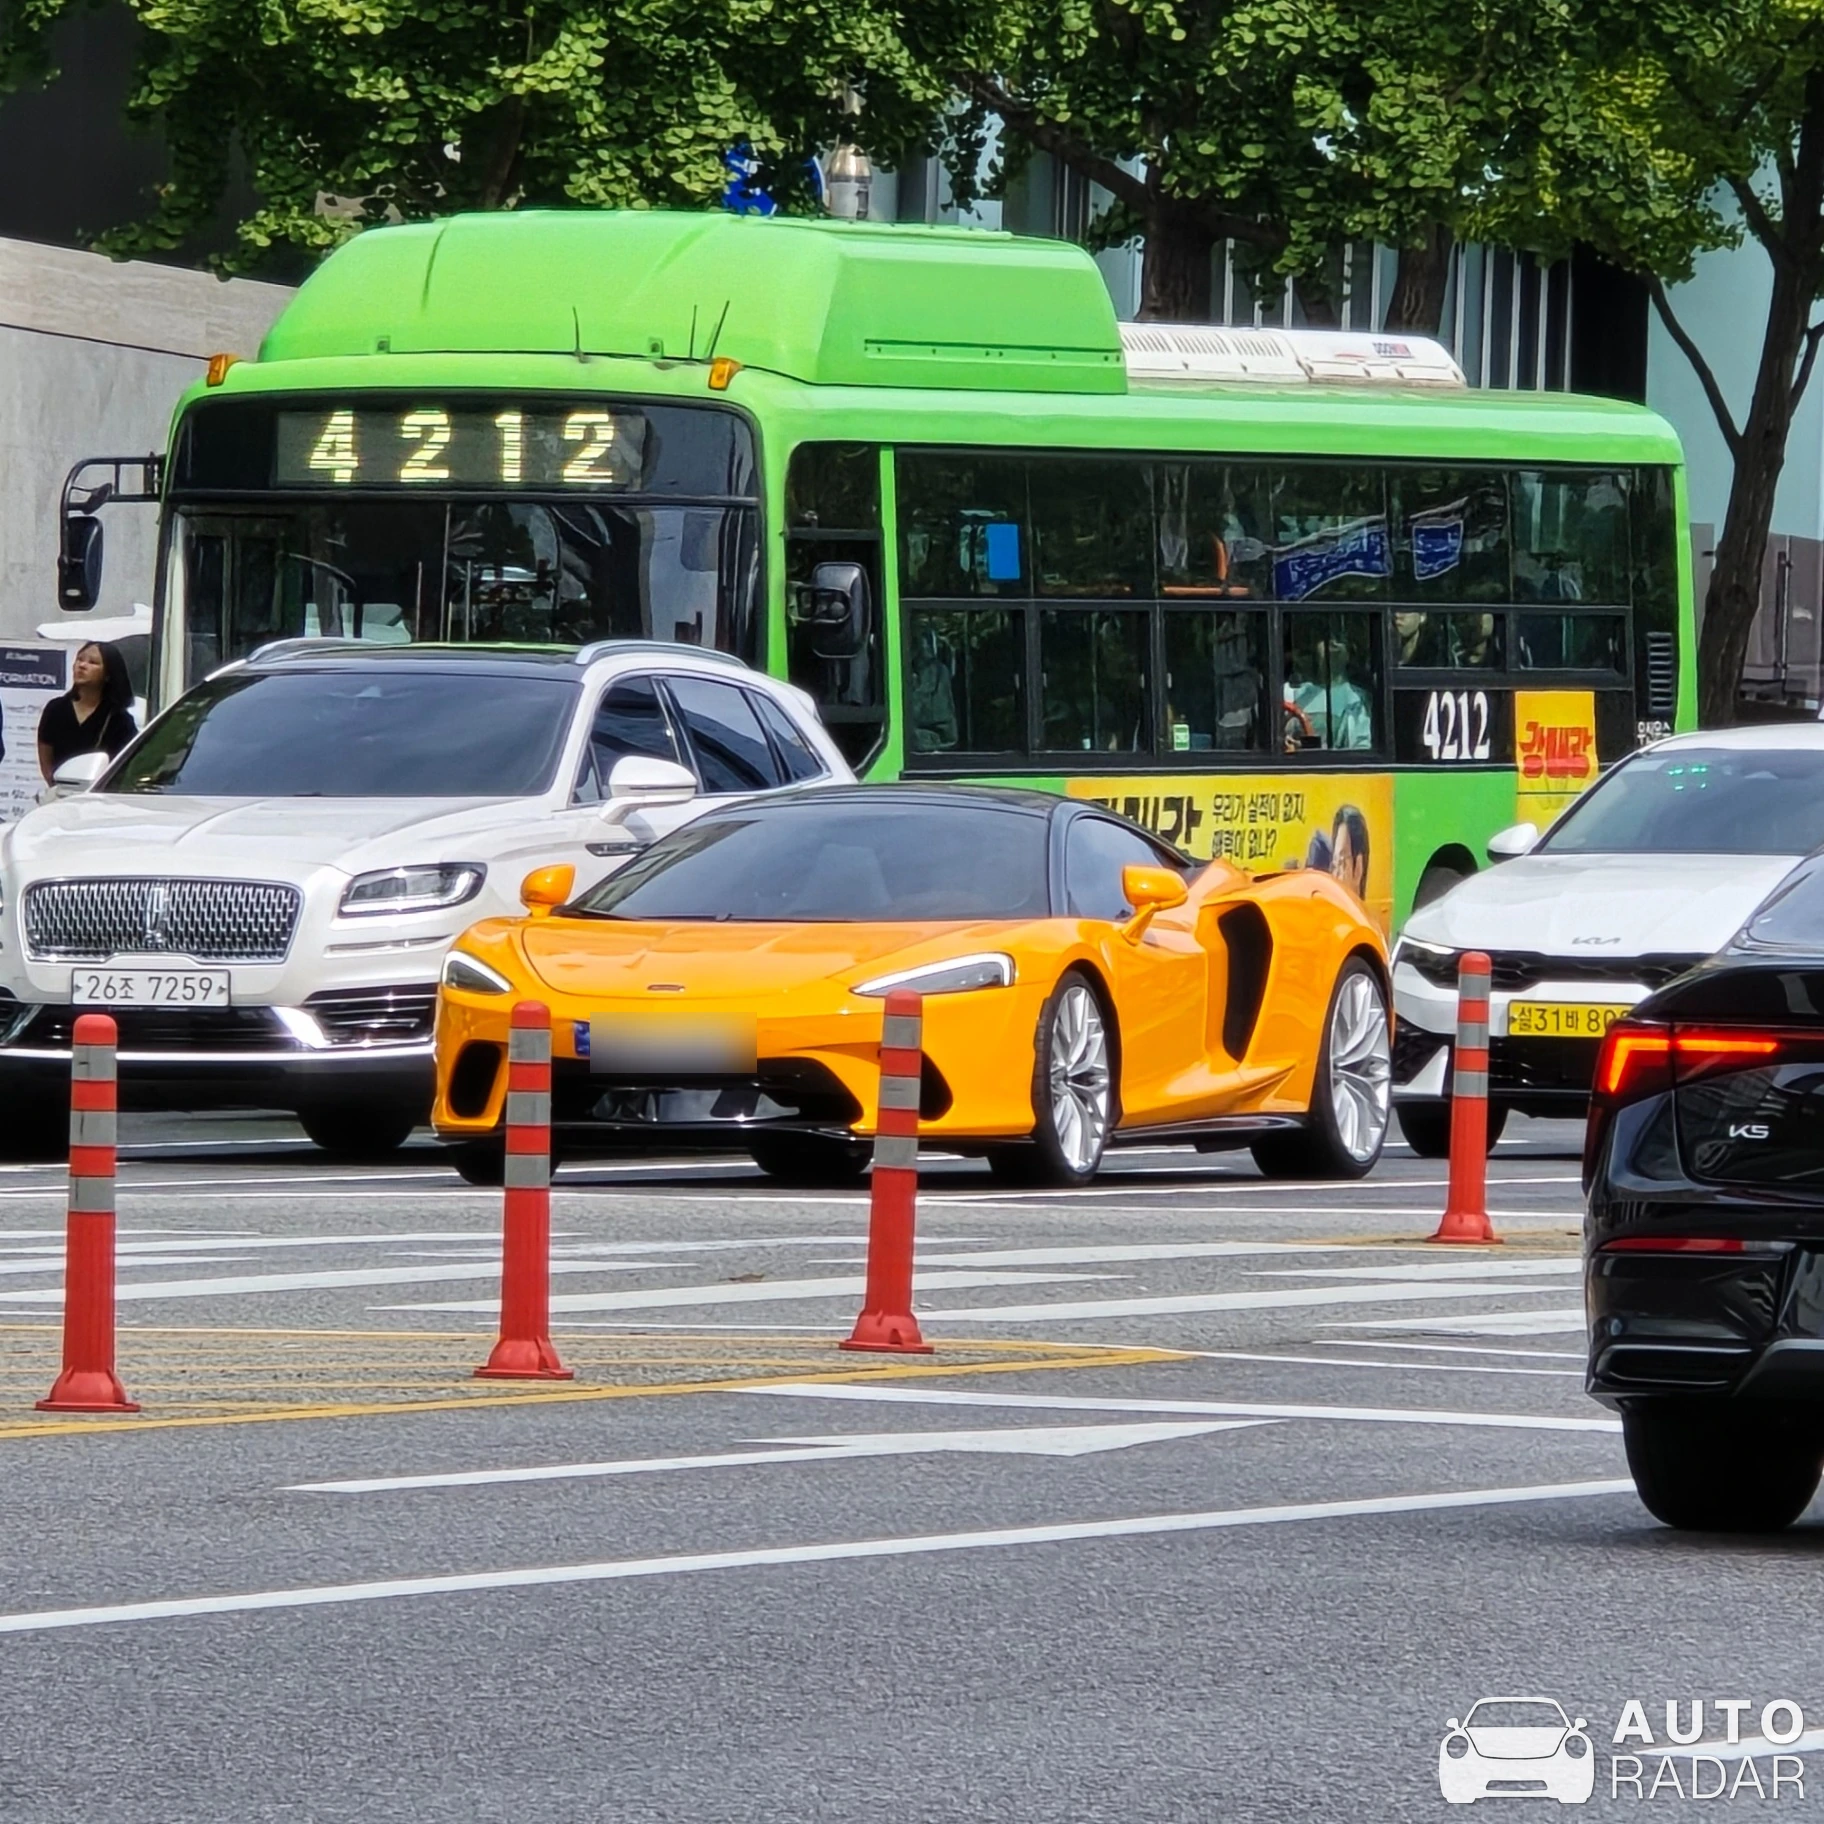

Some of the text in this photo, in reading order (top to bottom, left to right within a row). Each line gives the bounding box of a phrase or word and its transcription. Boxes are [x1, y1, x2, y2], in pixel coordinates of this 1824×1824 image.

[309, 410, 614, 483] 4212
[1423, 691, 1490, 760] 4212
[1212, 793, 1245, 824] 우리가
[1248, 793, 1280, 823] 실적이
[88, 975, 213, 1001] 26조 7259
[1729, 1124, 1769, 1139] K5
